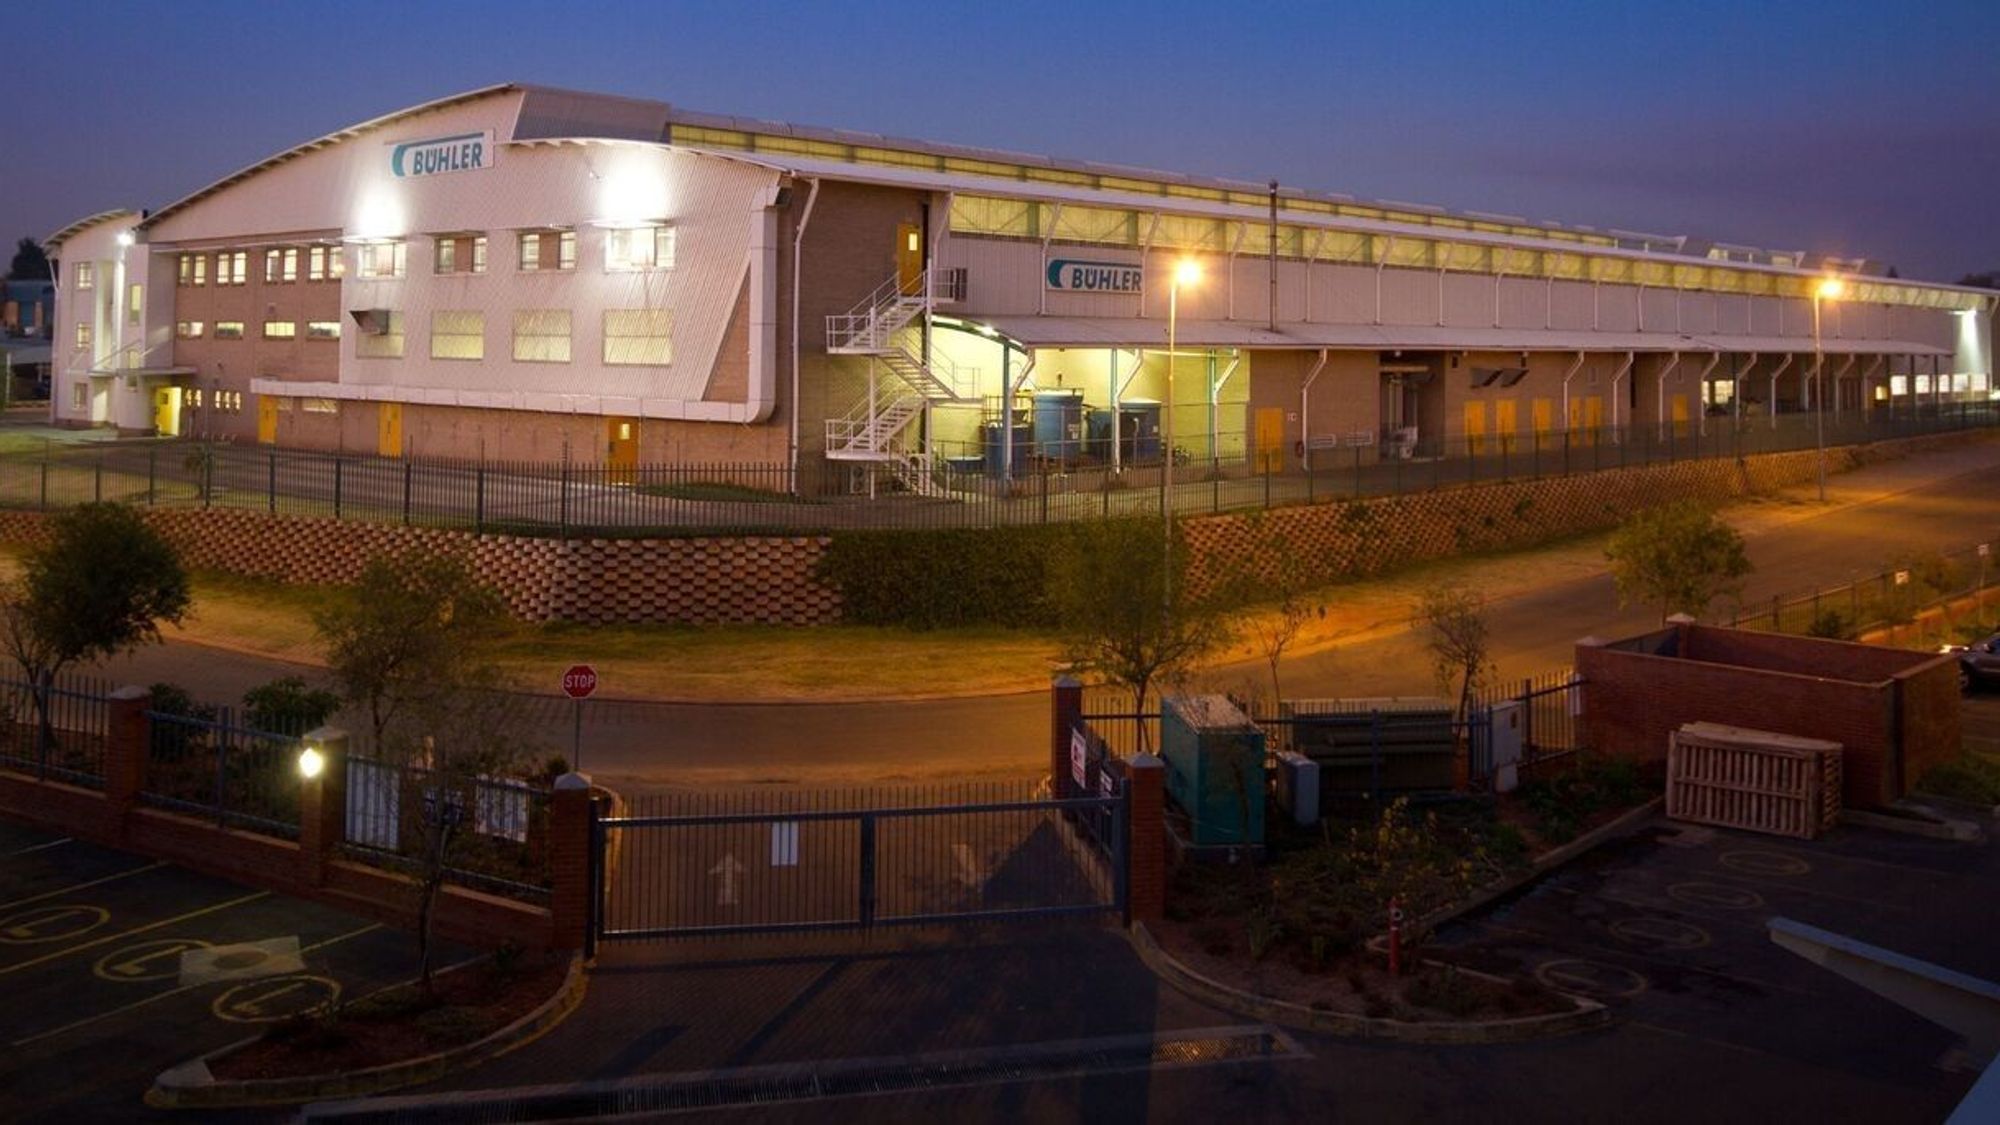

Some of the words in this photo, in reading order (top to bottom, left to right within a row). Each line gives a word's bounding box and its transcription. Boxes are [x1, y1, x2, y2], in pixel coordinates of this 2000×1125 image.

[413, 142, 482, 175] BÜHLER
[1072, 267, 1142, 291] BÜHLER
[564, 674, 594, 688] STOP
